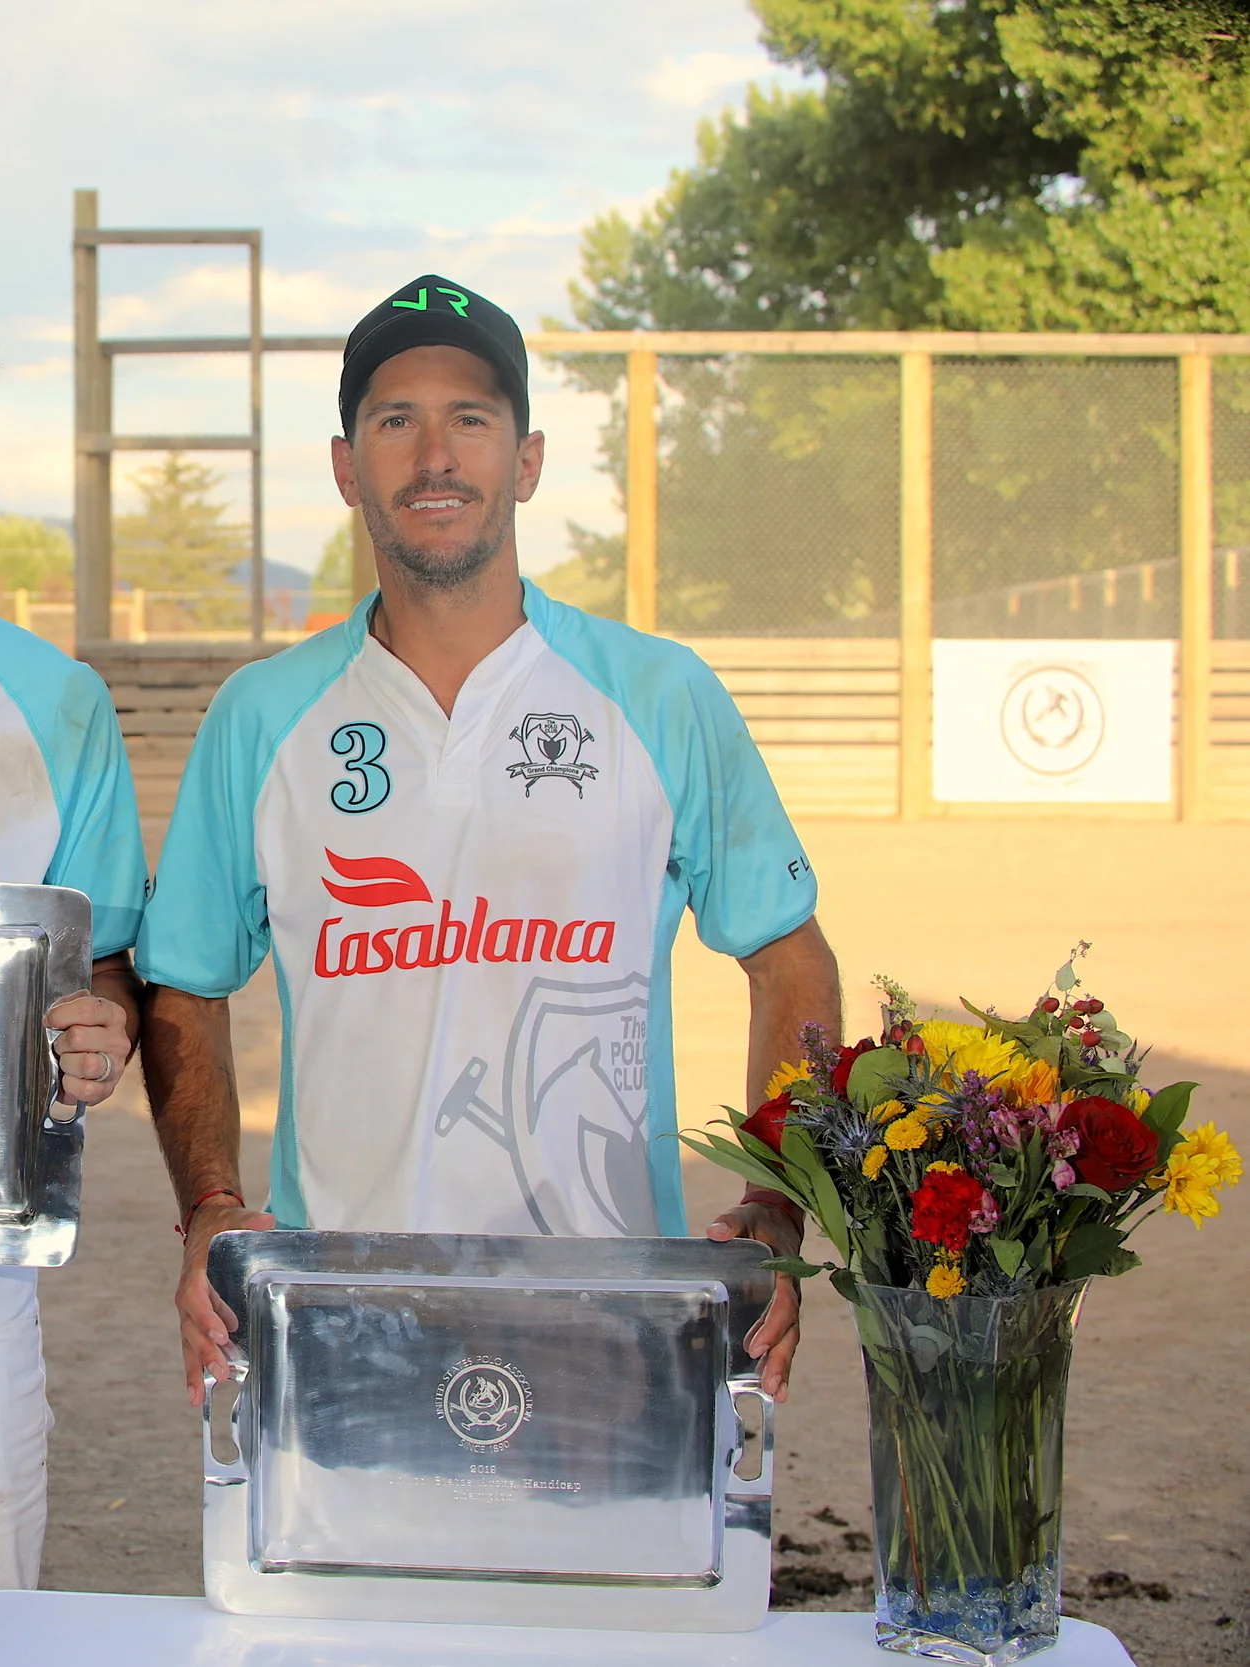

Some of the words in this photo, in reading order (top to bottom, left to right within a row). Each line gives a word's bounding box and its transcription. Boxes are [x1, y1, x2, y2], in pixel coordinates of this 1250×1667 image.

[328, 720, 393, 816] 3
[546, 765, 579, 775] Champions
[314, 896, 616, 979] Casablanca
[613, 1067, 648, 1092] CLU
[435, 1383, 446, 1420] UNITED
[443, 1357, 473, 1382] STATES
[476, 1355, 503, 1366] POLO
[504, 1362, 535, 1422] ASSOCIATION
[458, 1438, 486, 1454] SINCE
[523, 1478, 582, 1493] Handicap
